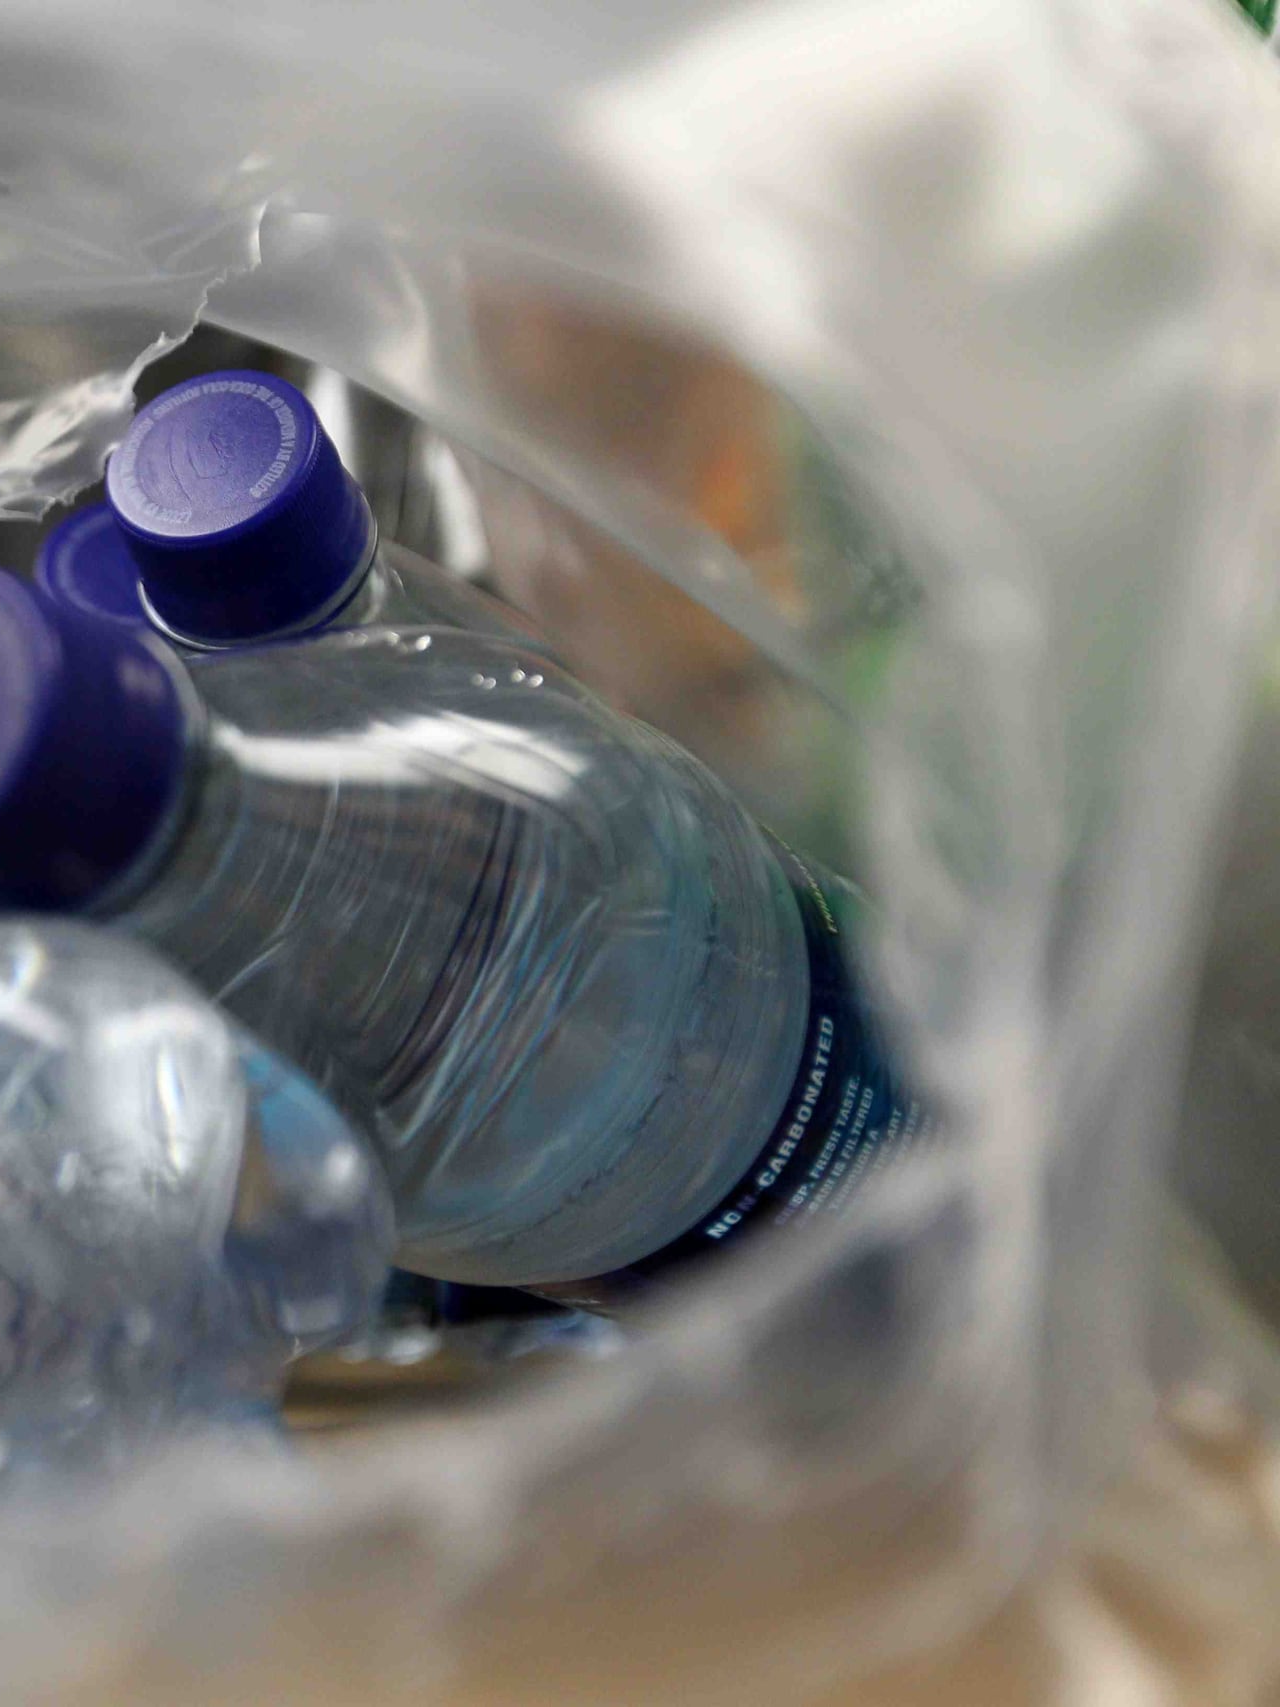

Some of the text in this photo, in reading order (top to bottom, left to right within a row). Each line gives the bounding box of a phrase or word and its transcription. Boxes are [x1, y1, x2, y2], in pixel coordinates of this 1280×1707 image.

[248, 459, 287, 498] BOTTLED
[278, 448, 294, 462] BY
[841, 1086, 874, 1161] FILTERED
[809, 1127, 842, 1179] FRESH
